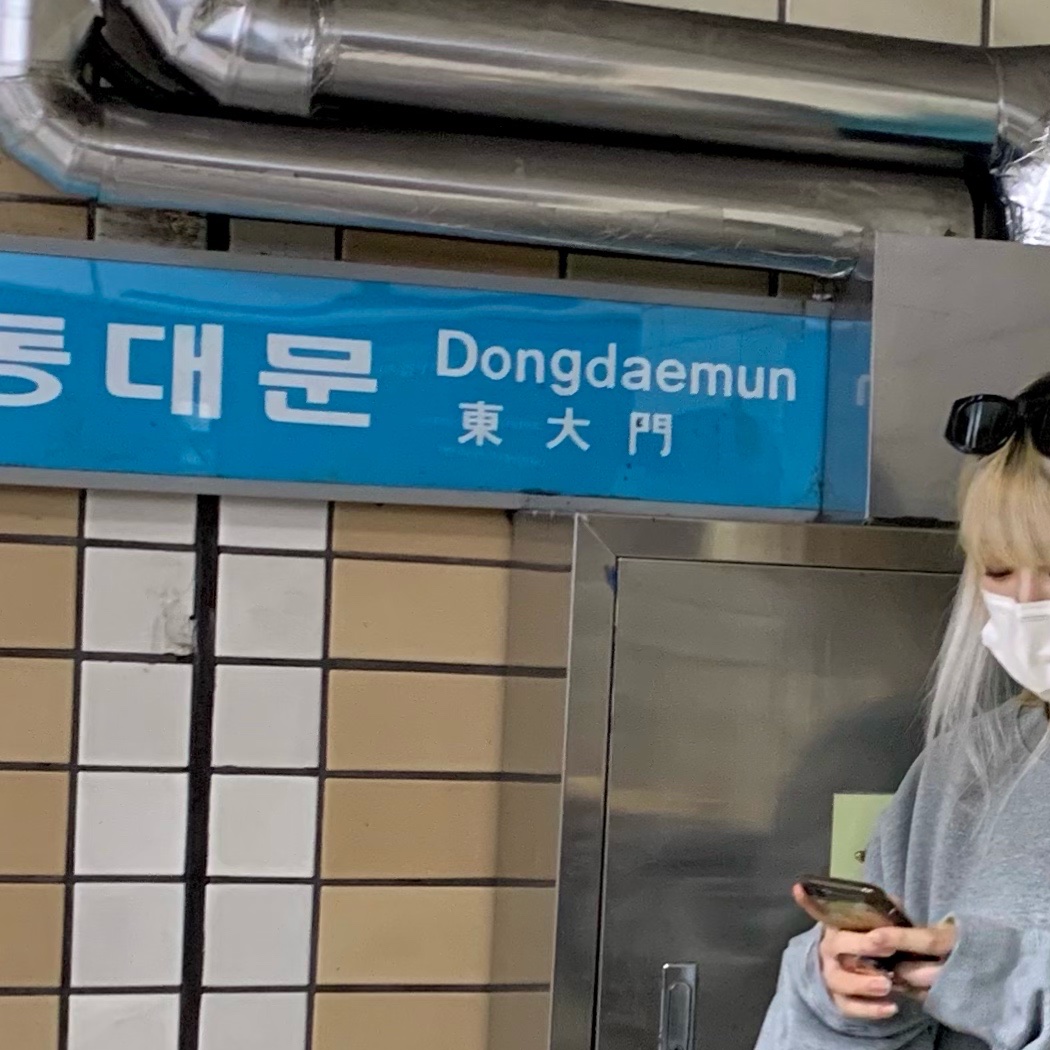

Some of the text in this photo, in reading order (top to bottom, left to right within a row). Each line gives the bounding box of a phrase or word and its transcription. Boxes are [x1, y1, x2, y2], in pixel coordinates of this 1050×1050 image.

[0, 313, 378, 427] 동대문
[436, 328, 797, 401] Dongdaemun
[458, 401, 673, 457] 東大門
